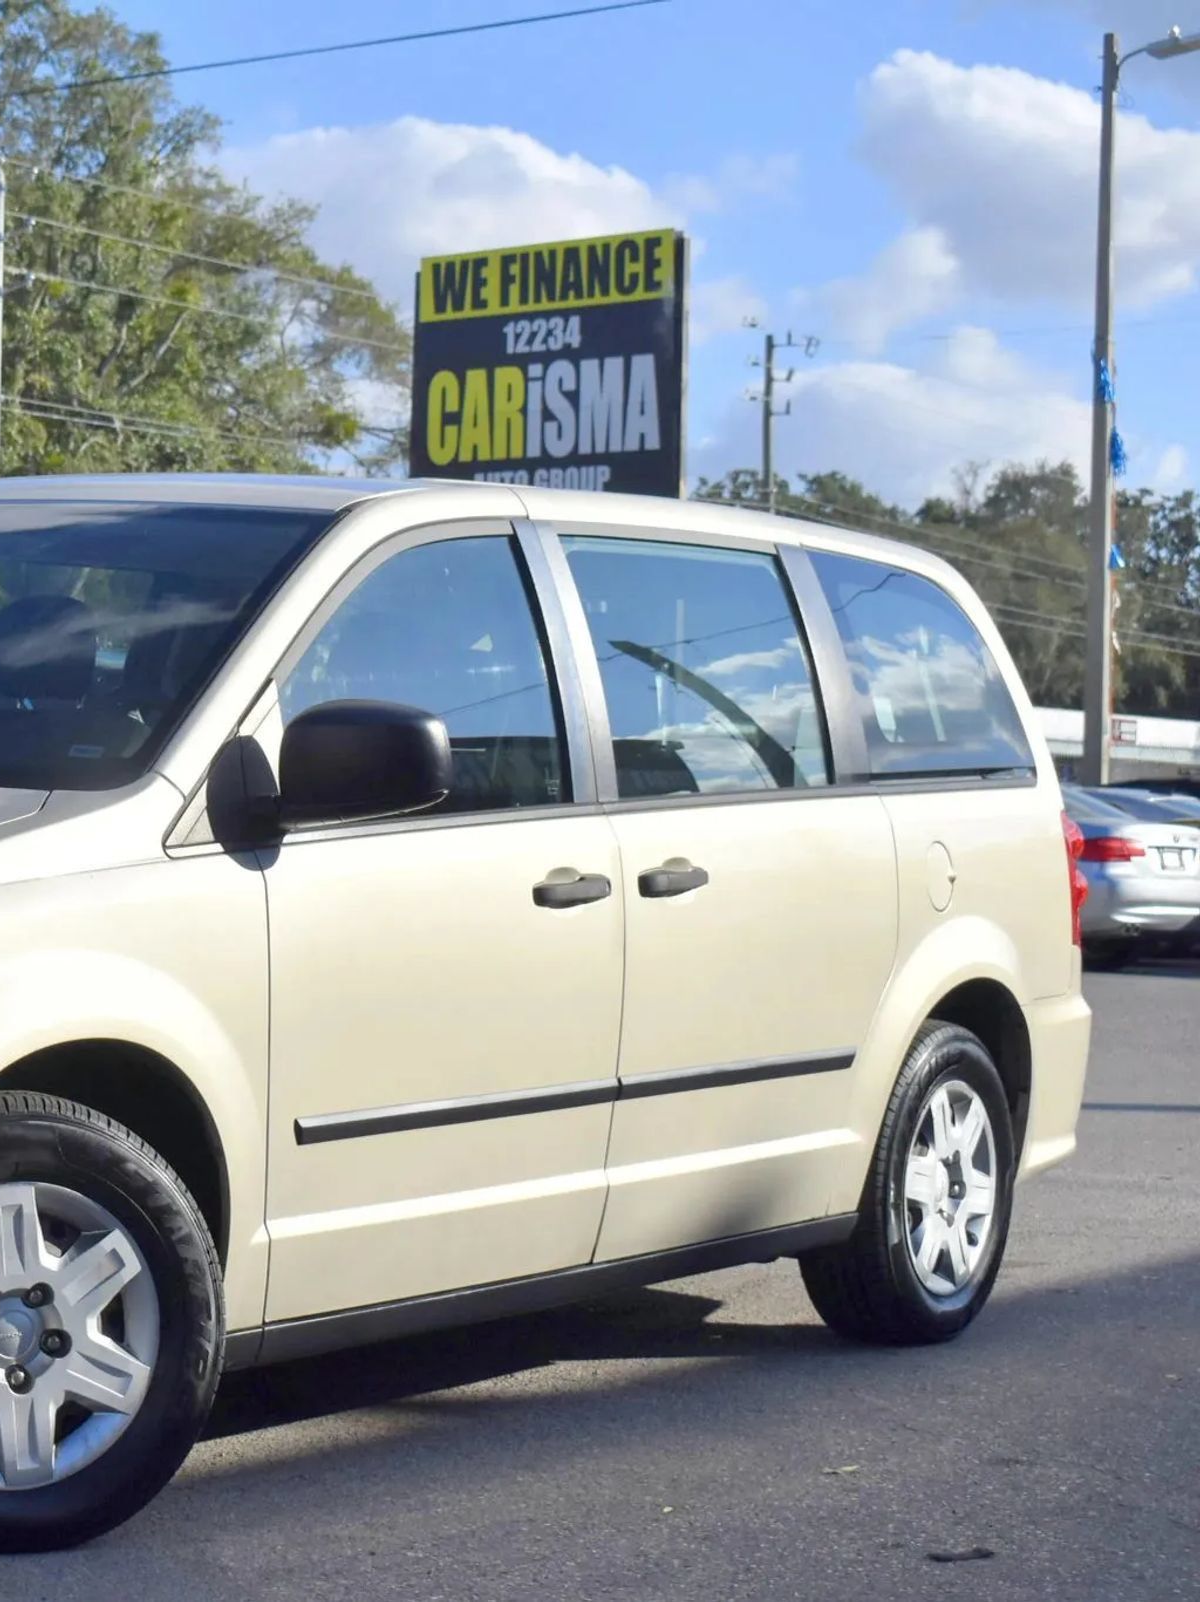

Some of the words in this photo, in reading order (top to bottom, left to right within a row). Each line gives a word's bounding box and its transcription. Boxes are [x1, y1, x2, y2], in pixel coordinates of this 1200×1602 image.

[431, 256, 489, 315] WE
[500, 236, 663, 308] FINANCE
[502, 315, 582, 354] 12234
